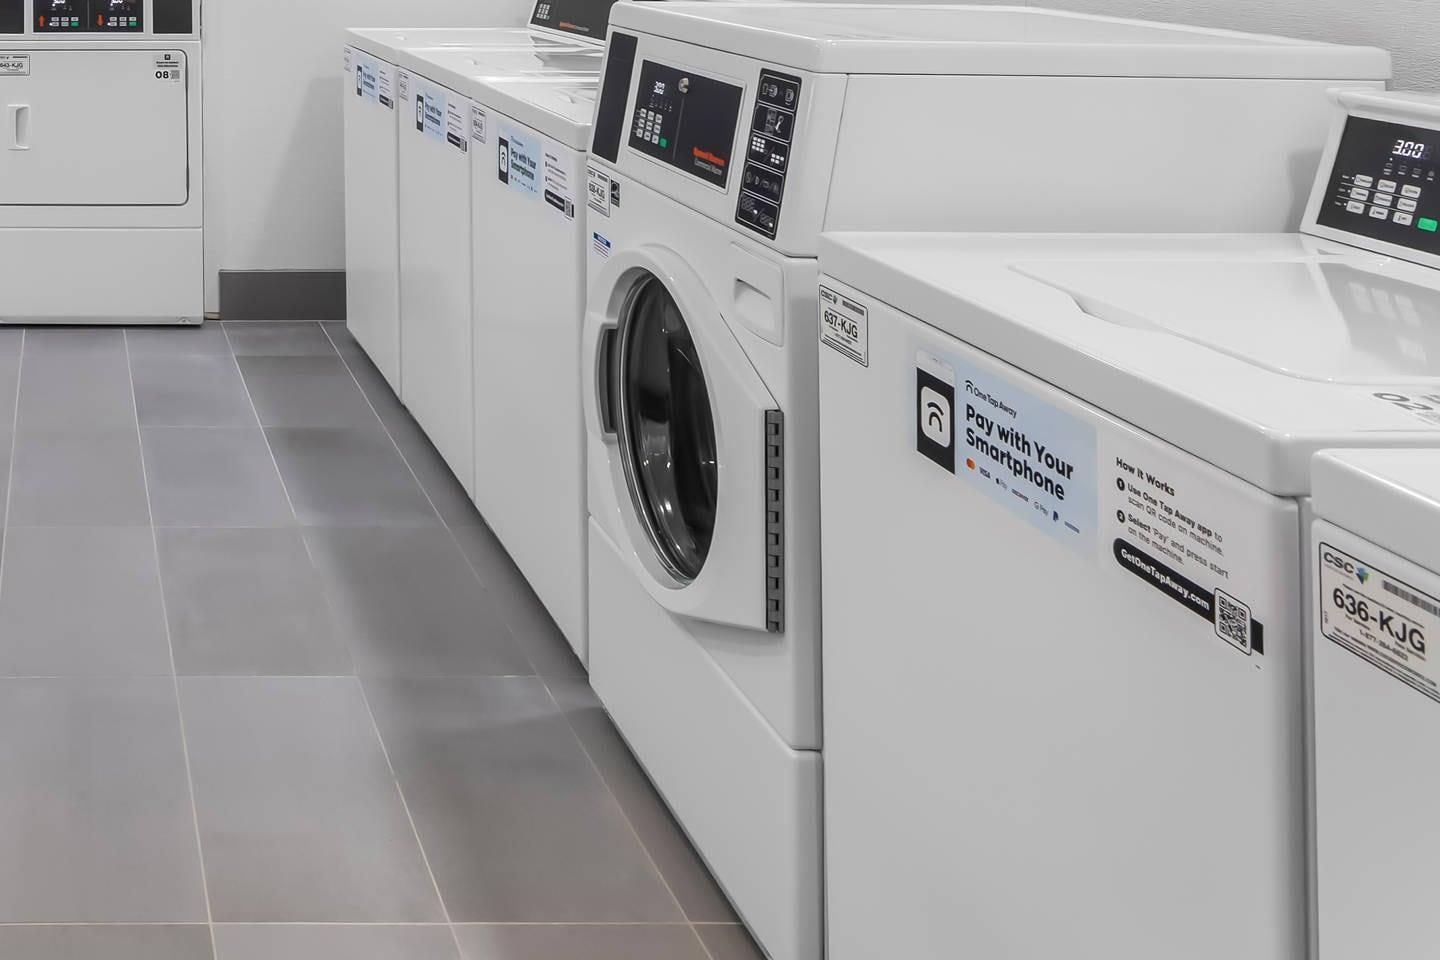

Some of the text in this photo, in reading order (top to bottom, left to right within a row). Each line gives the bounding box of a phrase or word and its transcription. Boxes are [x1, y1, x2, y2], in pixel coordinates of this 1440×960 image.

[155, 70, 169, 79] 08
[824, 310, 858, 338] 637-KJG
[974, 387, 1017, 419] One Tap Away
[966, 403, 1074, 480] Pay with Your
[966, 427, 1065, 501] Smartphone
[1116, 456, 1135, 474] How
[1145, 472, 1175, 496] Works
[1127, 483, 1141, 497] Use
[1143, 492, 1158, 506] One
[1159, 500, 1173, 515] Tap
[1174, 509, 1196, 528] Away
[1197, 524, 1212, 537] app
[1214, 532, 1223, 542] to
[1146, 505, 1156, 517] QR
[1158, 514, 1176, 528] code
[1178, 524, 1188, 536] on
[1128, 513, 1151, 533] Select
[1170, 540, 1185, 553] and
[1186, 548, 1207, 566] press
[1209, 562, 1229, 579] start
[1323, 551, 1354, 574] CSC
[1120, 548, 1210, 611] GetOneTapAway.com
[1333, 588, 1426, 655] 636-KJG
